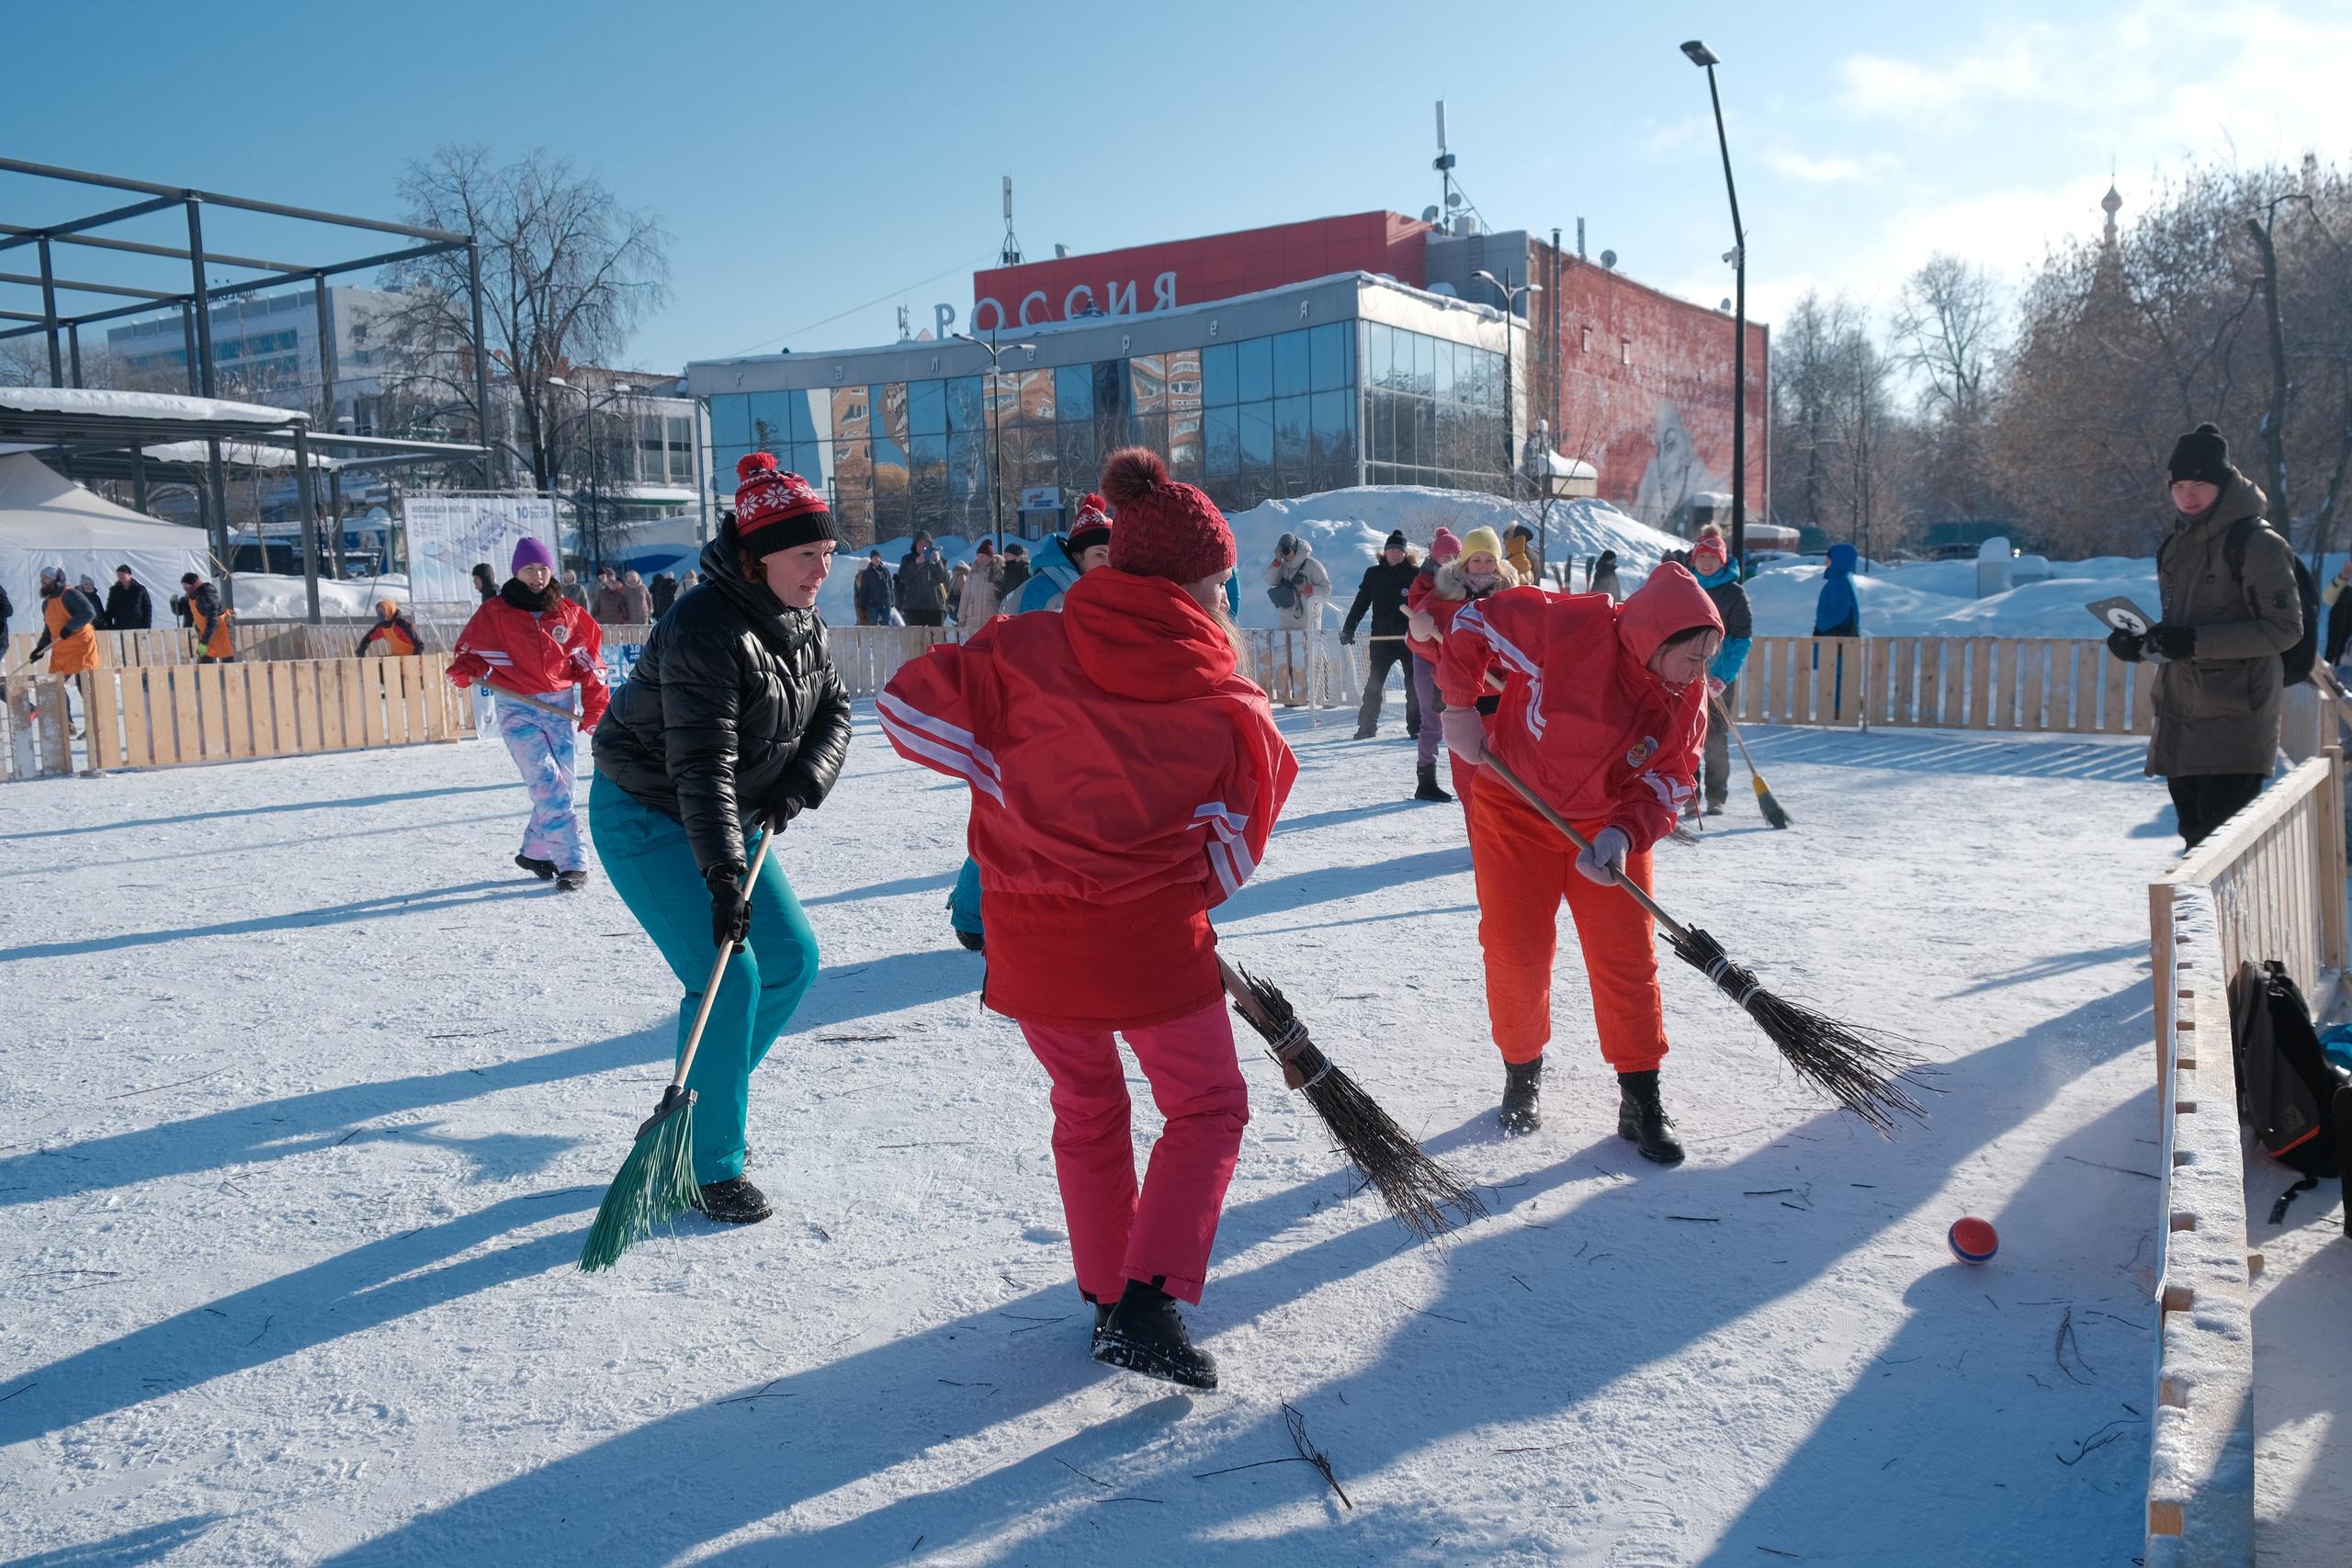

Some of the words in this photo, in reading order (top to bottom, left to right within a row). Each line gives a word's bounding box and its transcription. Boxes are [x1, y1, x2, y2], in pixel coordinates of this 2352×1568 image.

[933, 270, 1176, 340] РОССИЯ
[515, 506, 528, 518] 10
[629, 645, 640, 653] 10
